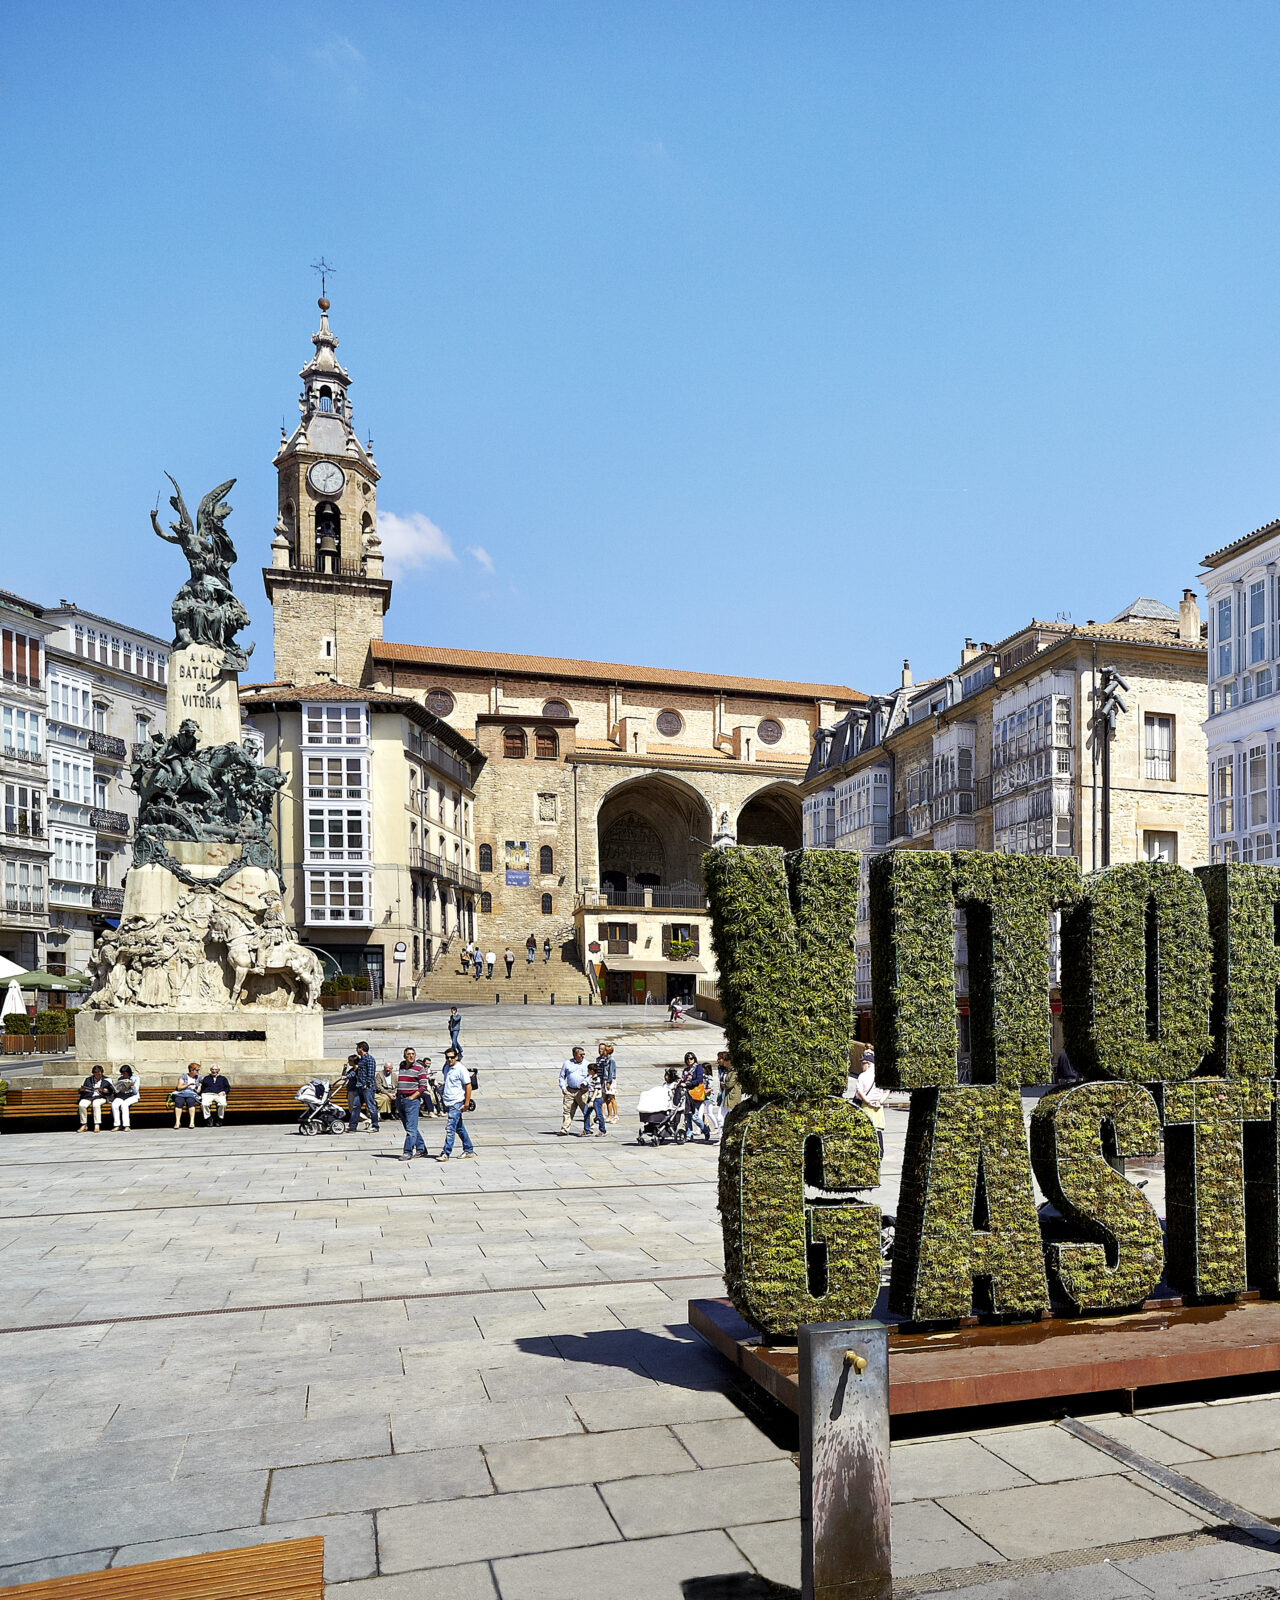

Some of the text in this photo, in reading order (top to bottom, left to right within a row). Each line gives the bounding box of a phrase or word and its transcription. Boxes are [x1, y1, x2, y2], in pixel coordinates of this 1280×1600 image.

[190, 652, 212, 663] A LA
[179, 664, 217, 681] BATALL
[196, 683, 207, 692] DE
[181, 694, 222, 710] VITORIA
